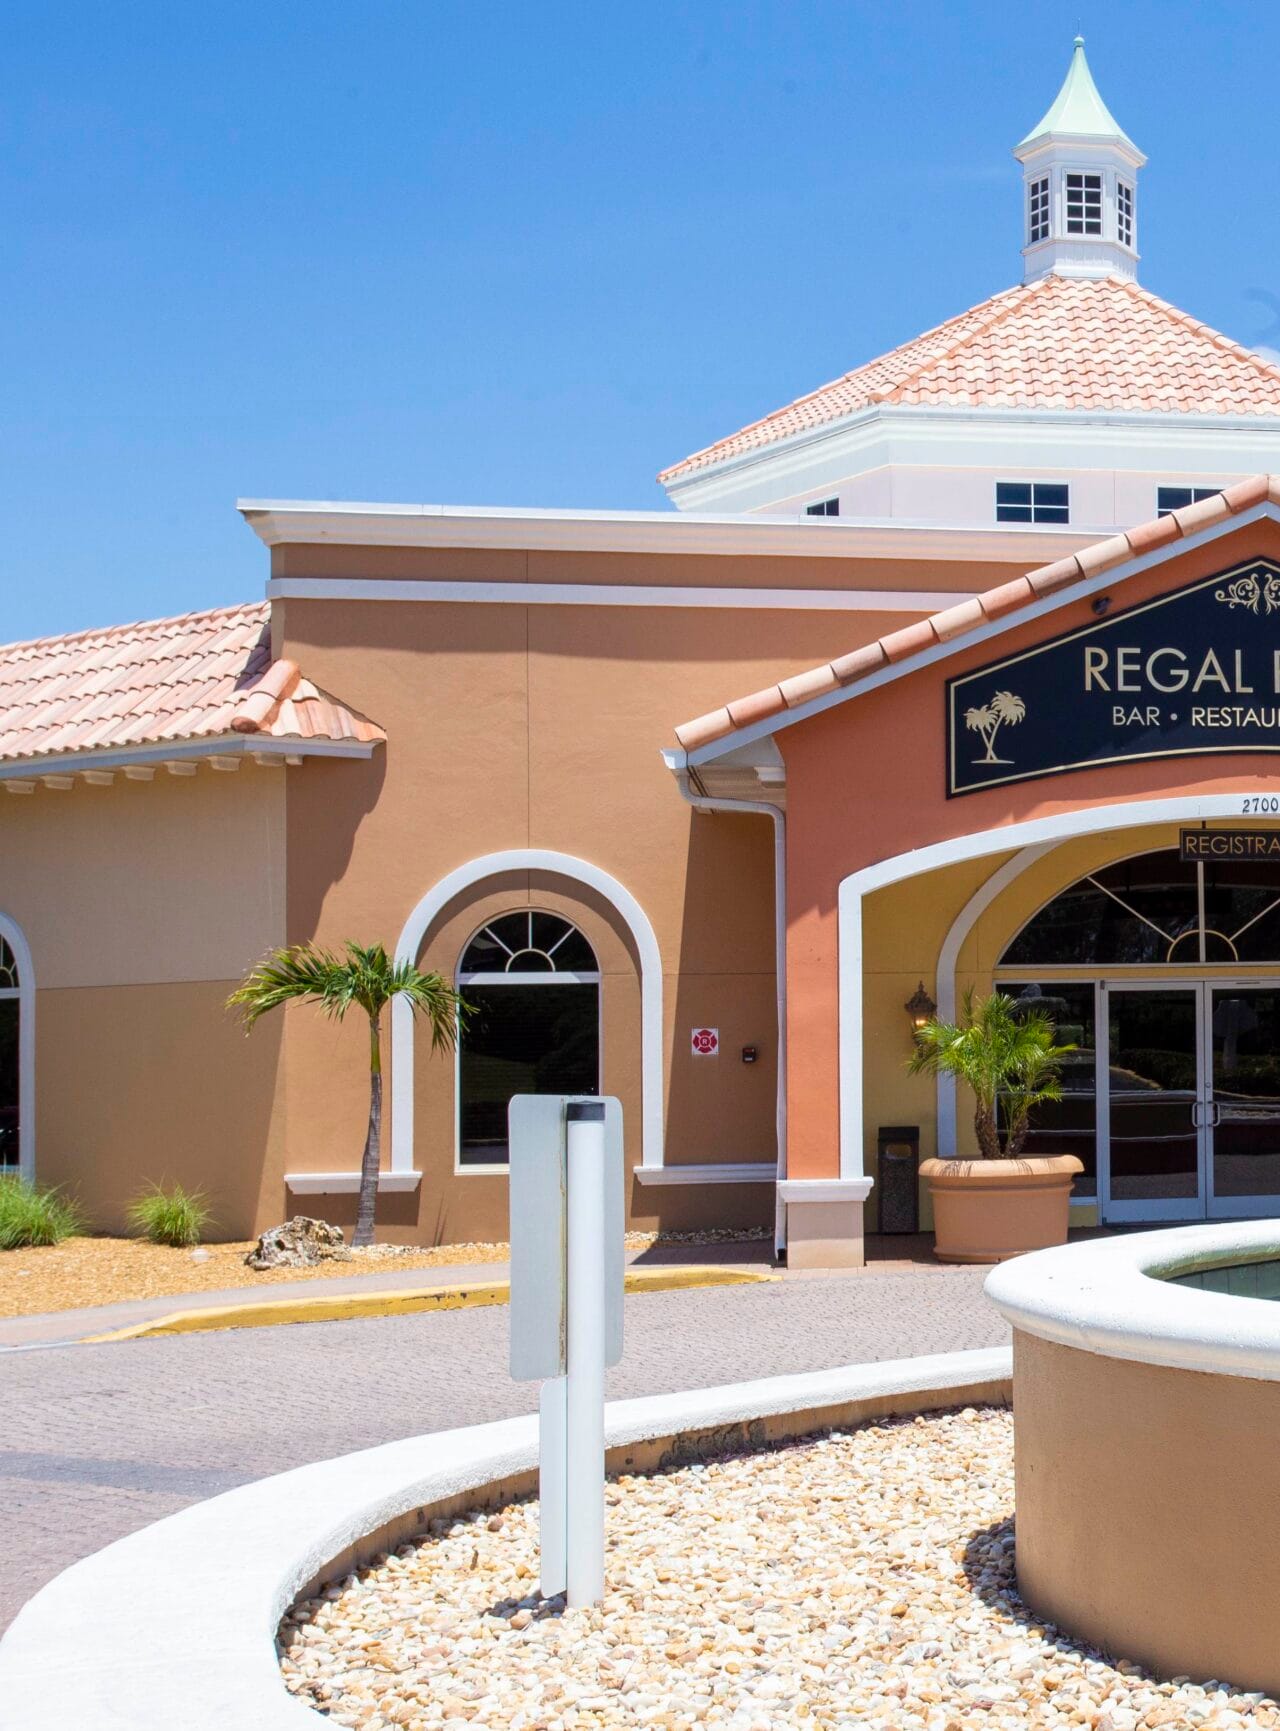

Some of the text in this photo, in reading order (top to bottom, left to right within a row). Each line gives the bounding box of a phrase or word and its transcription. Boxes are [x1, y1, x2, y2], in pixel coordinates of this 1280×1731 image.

[1084, 647, 1253, 693] REGAL
[1112, 706, 1160, 726] BAR
[1242, 797, 1279, 813] 2700
